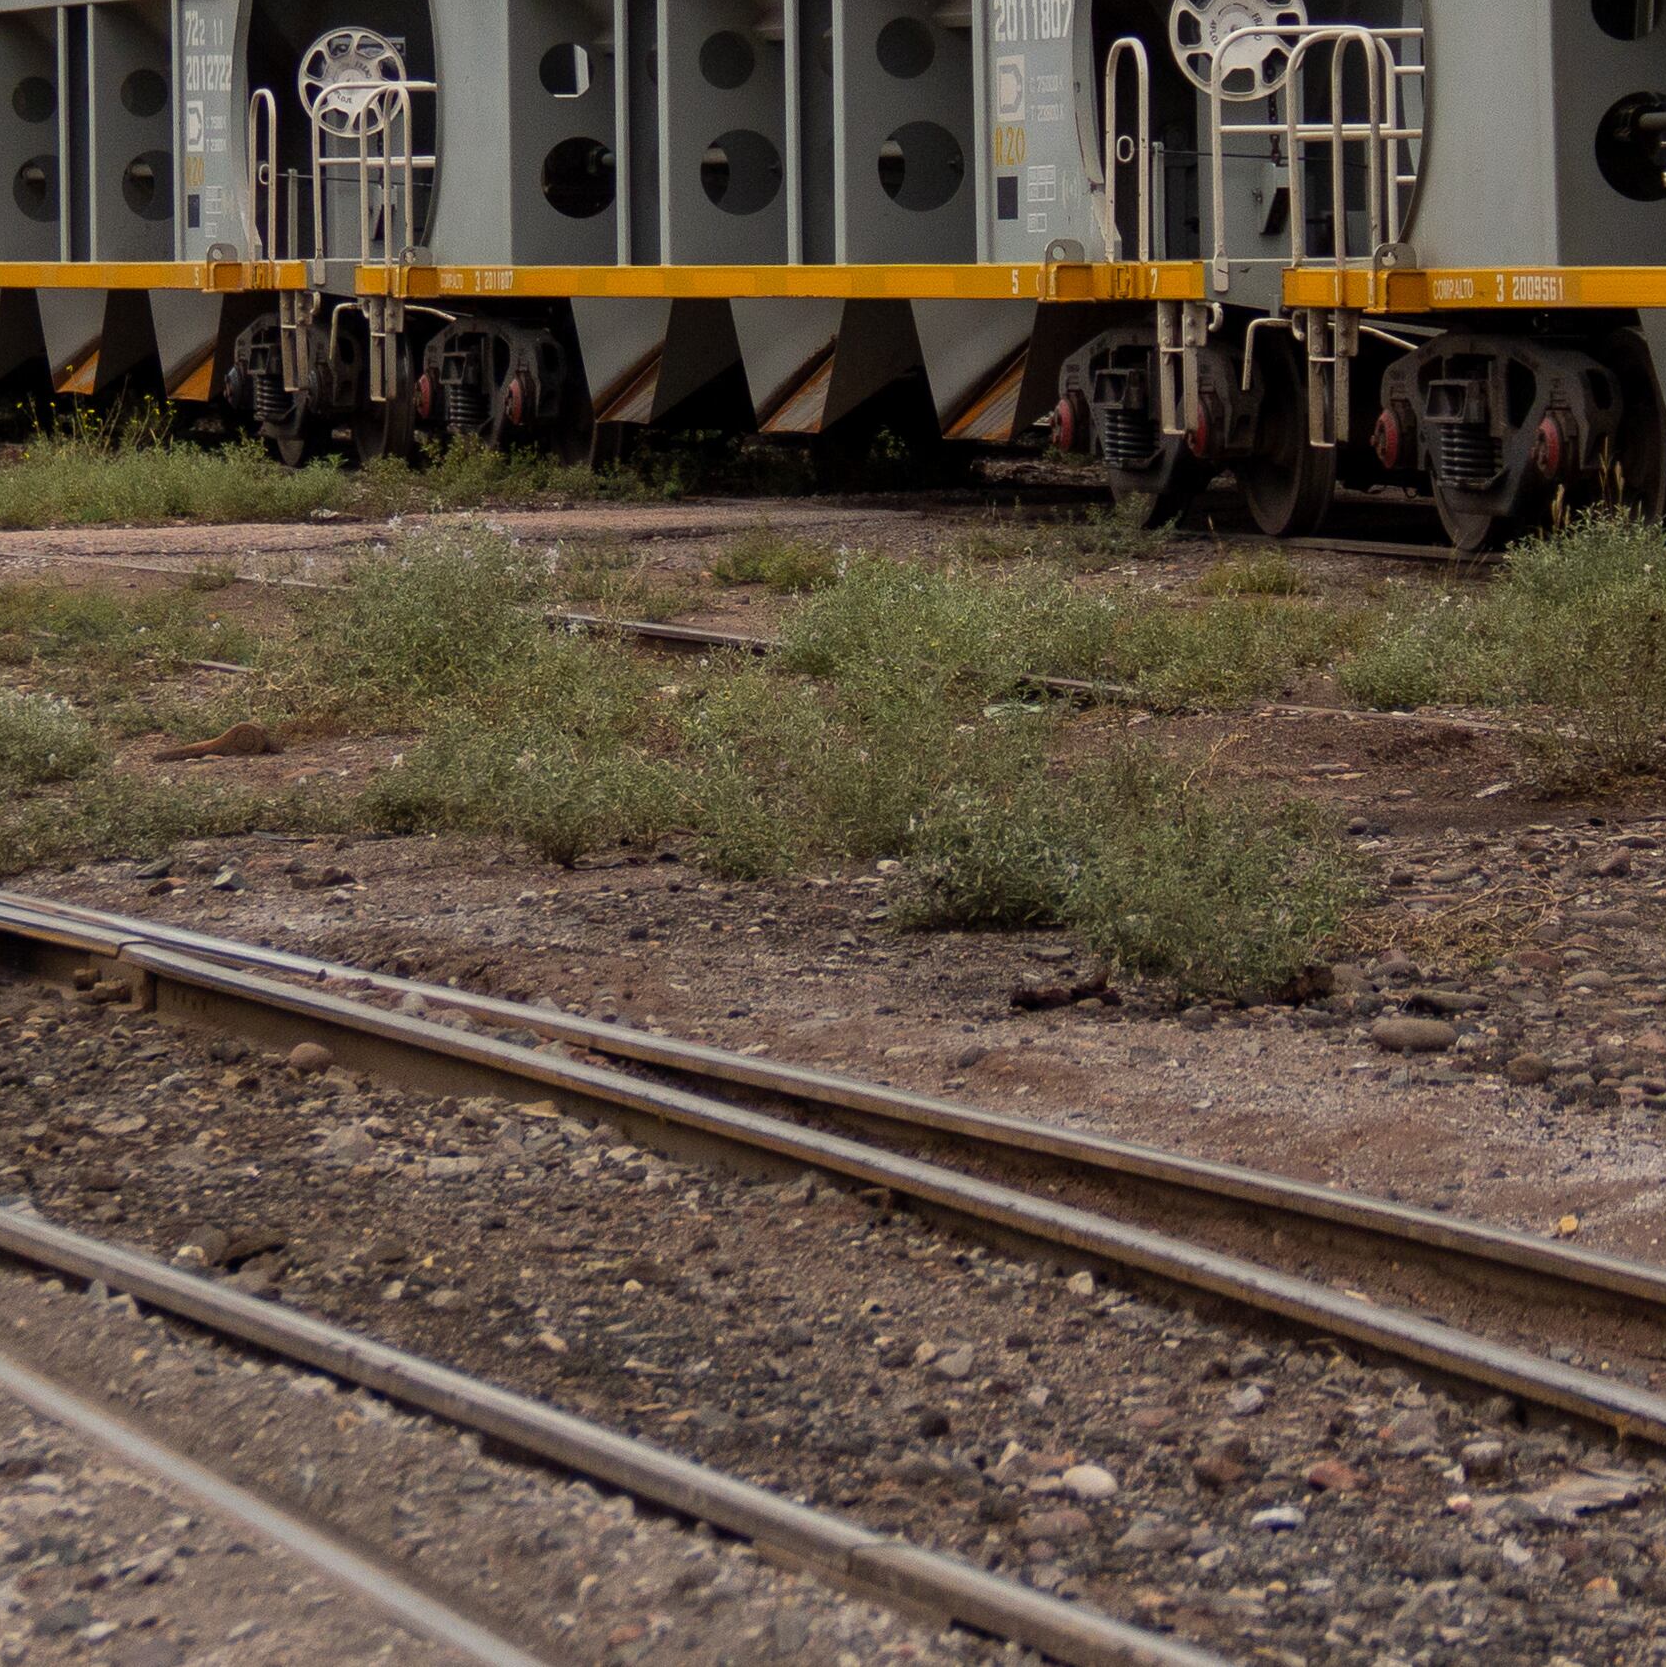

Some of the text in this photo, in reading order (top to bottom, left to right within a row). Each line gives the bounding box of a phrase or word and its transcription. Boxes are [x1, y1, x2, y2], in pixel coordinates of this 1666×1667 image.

[186, 54, 233, 92] 2012722
[1011, 269, 1019, 295] 5
[1151, 269, 1158, 294] 7
[1496, 274, 1564, 302] 3 2009561
